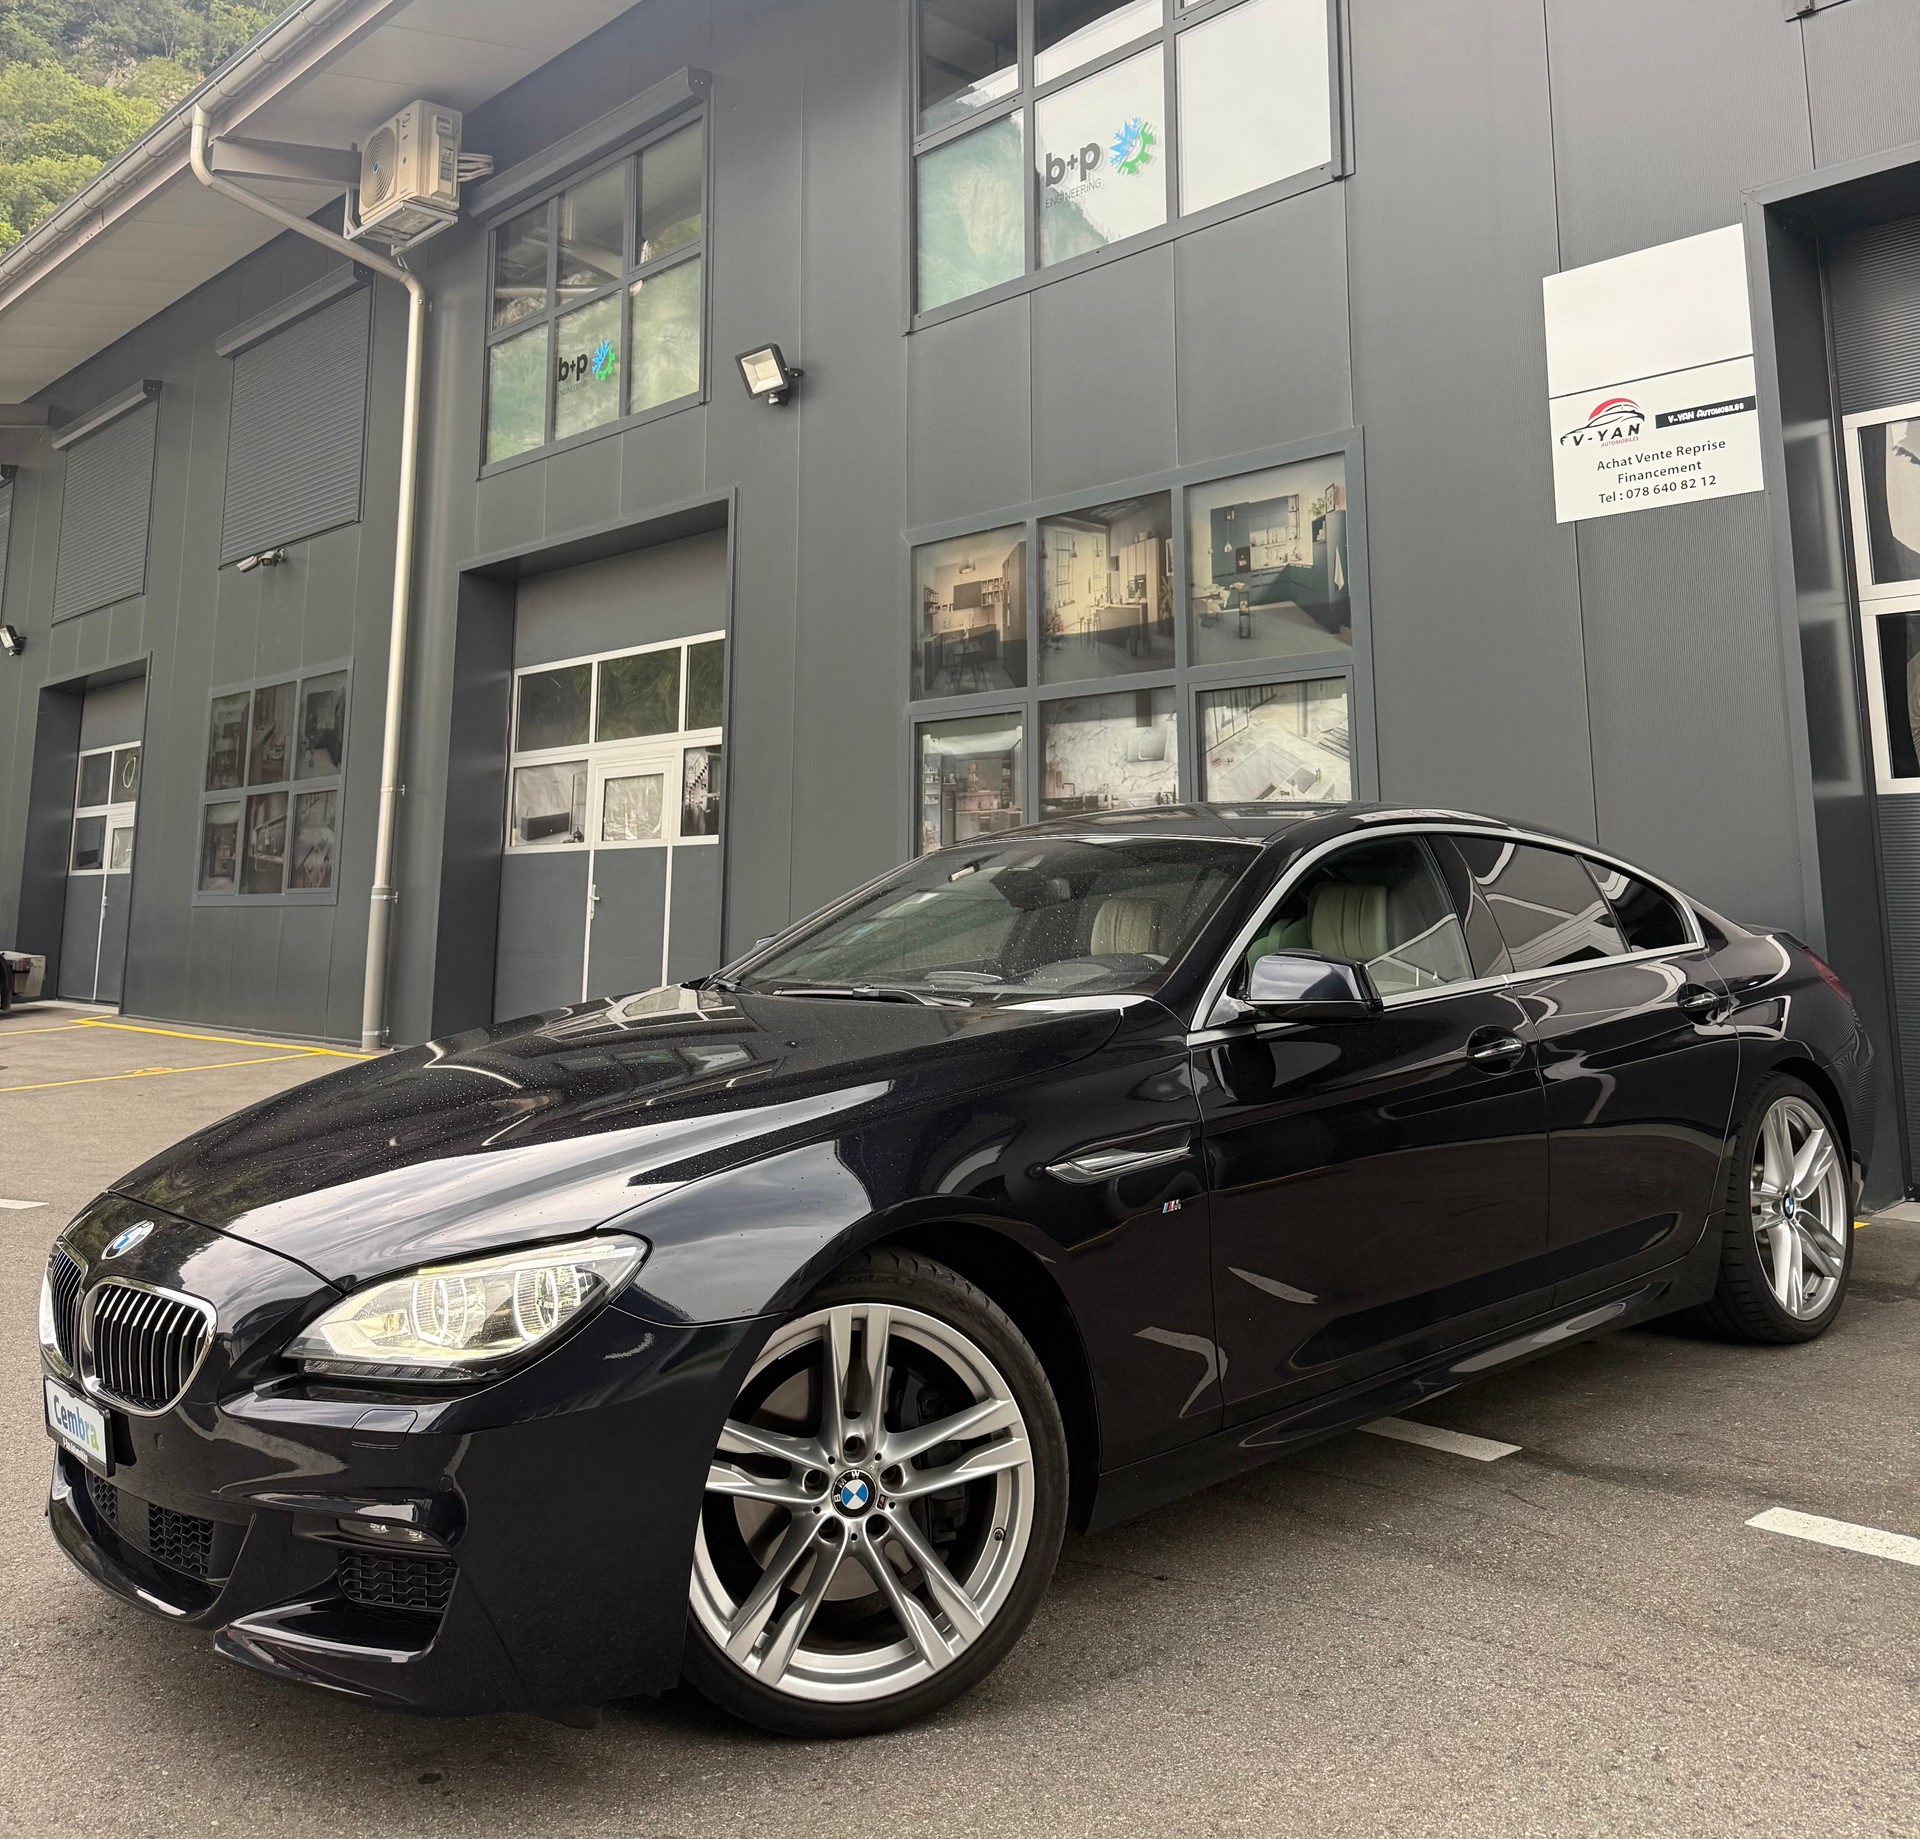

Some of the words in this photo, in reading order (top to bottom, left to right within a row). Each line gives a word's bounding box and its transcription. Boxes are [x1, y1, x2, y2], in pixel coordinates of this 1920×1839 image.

[1045, 142, 1101, 187] b+p
[1045, 178, 1102, 209] ENGINEERING
[558, 353, 588, 382] b+p
[559, 379, 588, 396] NGINEERING
[1667, 410, 1695, 424] V-YAN
[1573, 423, 1640, 446] V-YAN
[1601, 436, 1640, 447] AUTOMOBILES
[1597, 456, 1633, 471] Achat
[1635, 450, 1673, 464] Vente
[1676, 440, 1726, 457] Reprise
[1618, 460, 1702, 484] Financement
[1626, 486, 1650, 500] 078
[1653, 481, 1677, 495] 640
[1681, 478, 1697, 490] 82
[1701, 475, 1717, 487] 12
[53, 1394, 100, 1451] Cembra
